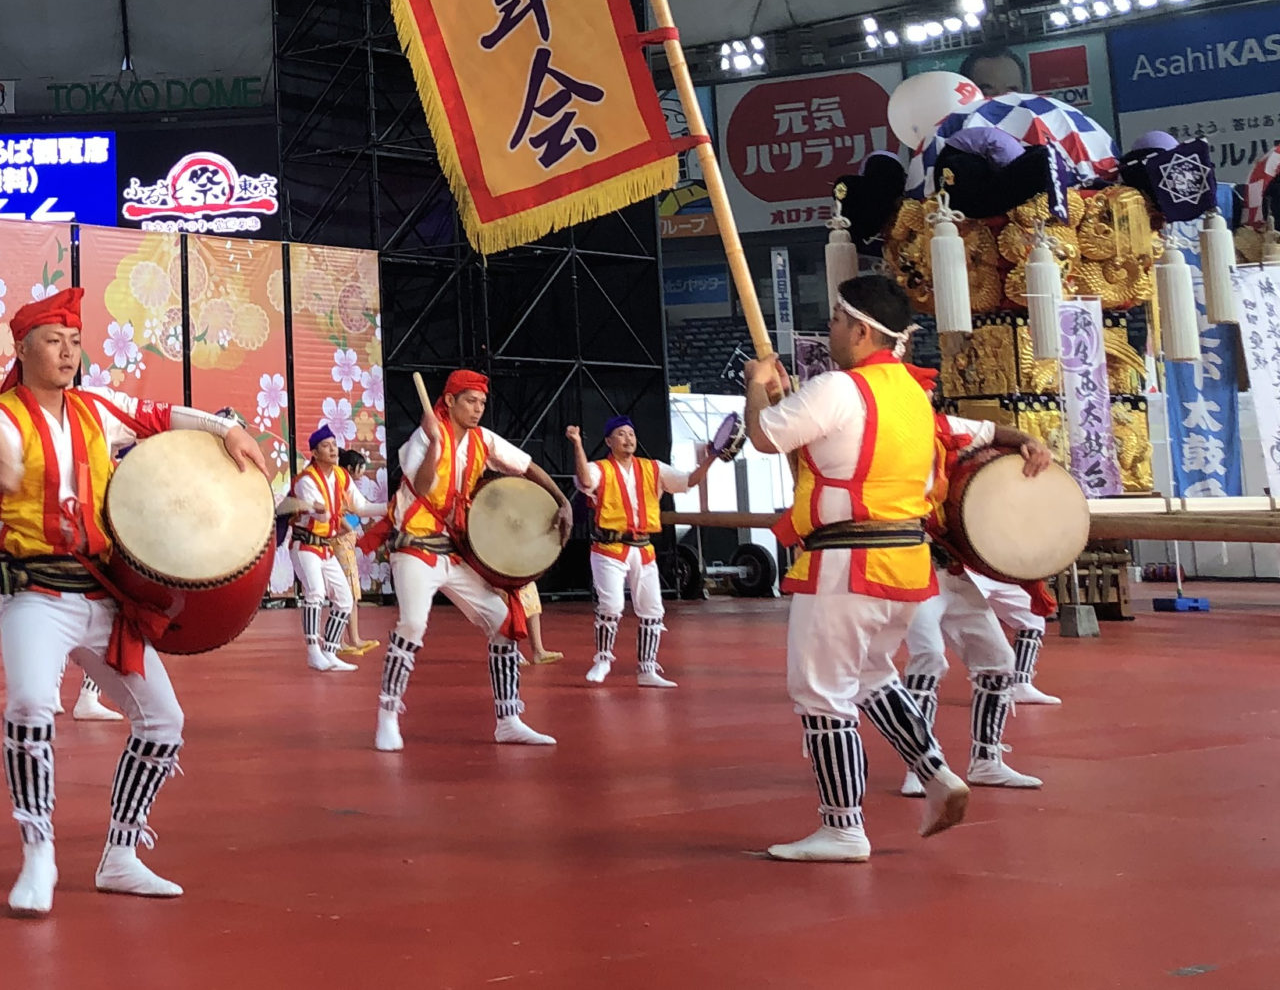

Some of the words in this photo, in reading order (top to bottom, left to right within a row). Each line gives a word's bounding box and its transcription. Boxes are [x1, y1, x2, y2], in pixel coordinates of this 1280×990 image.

[1130, 33, 1280, 82] AsahiKAS
[46, 80, 160, 111] TOKYO
[165, 77, 263, 108] DOME
[773, 96, 847, 136] 元気
